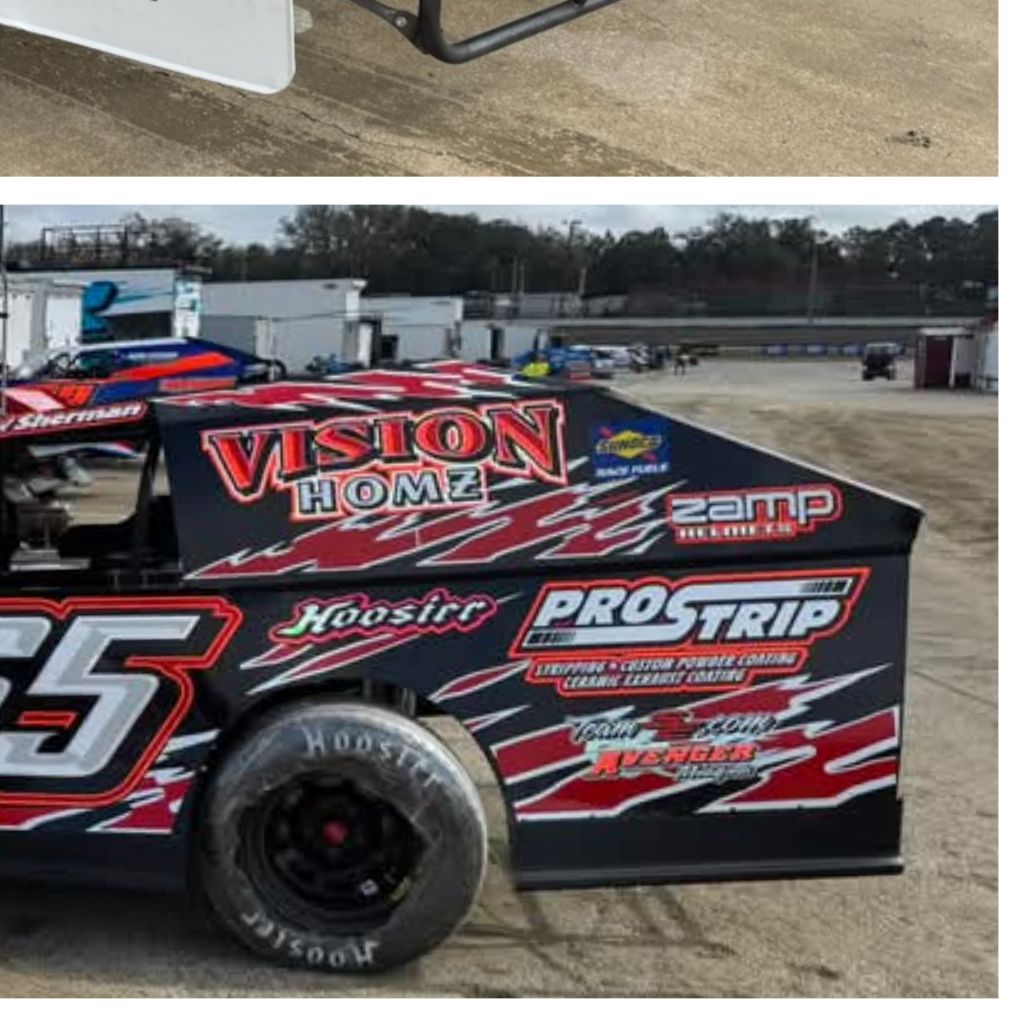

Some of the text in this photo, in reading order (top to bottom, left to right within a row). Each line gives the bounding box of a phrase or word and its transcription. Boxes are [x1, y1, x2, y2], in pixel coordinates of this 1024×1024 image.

[14, 403, 142, 430] Sherman
[205, 401, 566, 498] VISION
[296, 466, 483, 514] HOMZ
[671, 490, 834, 525] zamp
[592, 742, 758, 775] AVENGER
